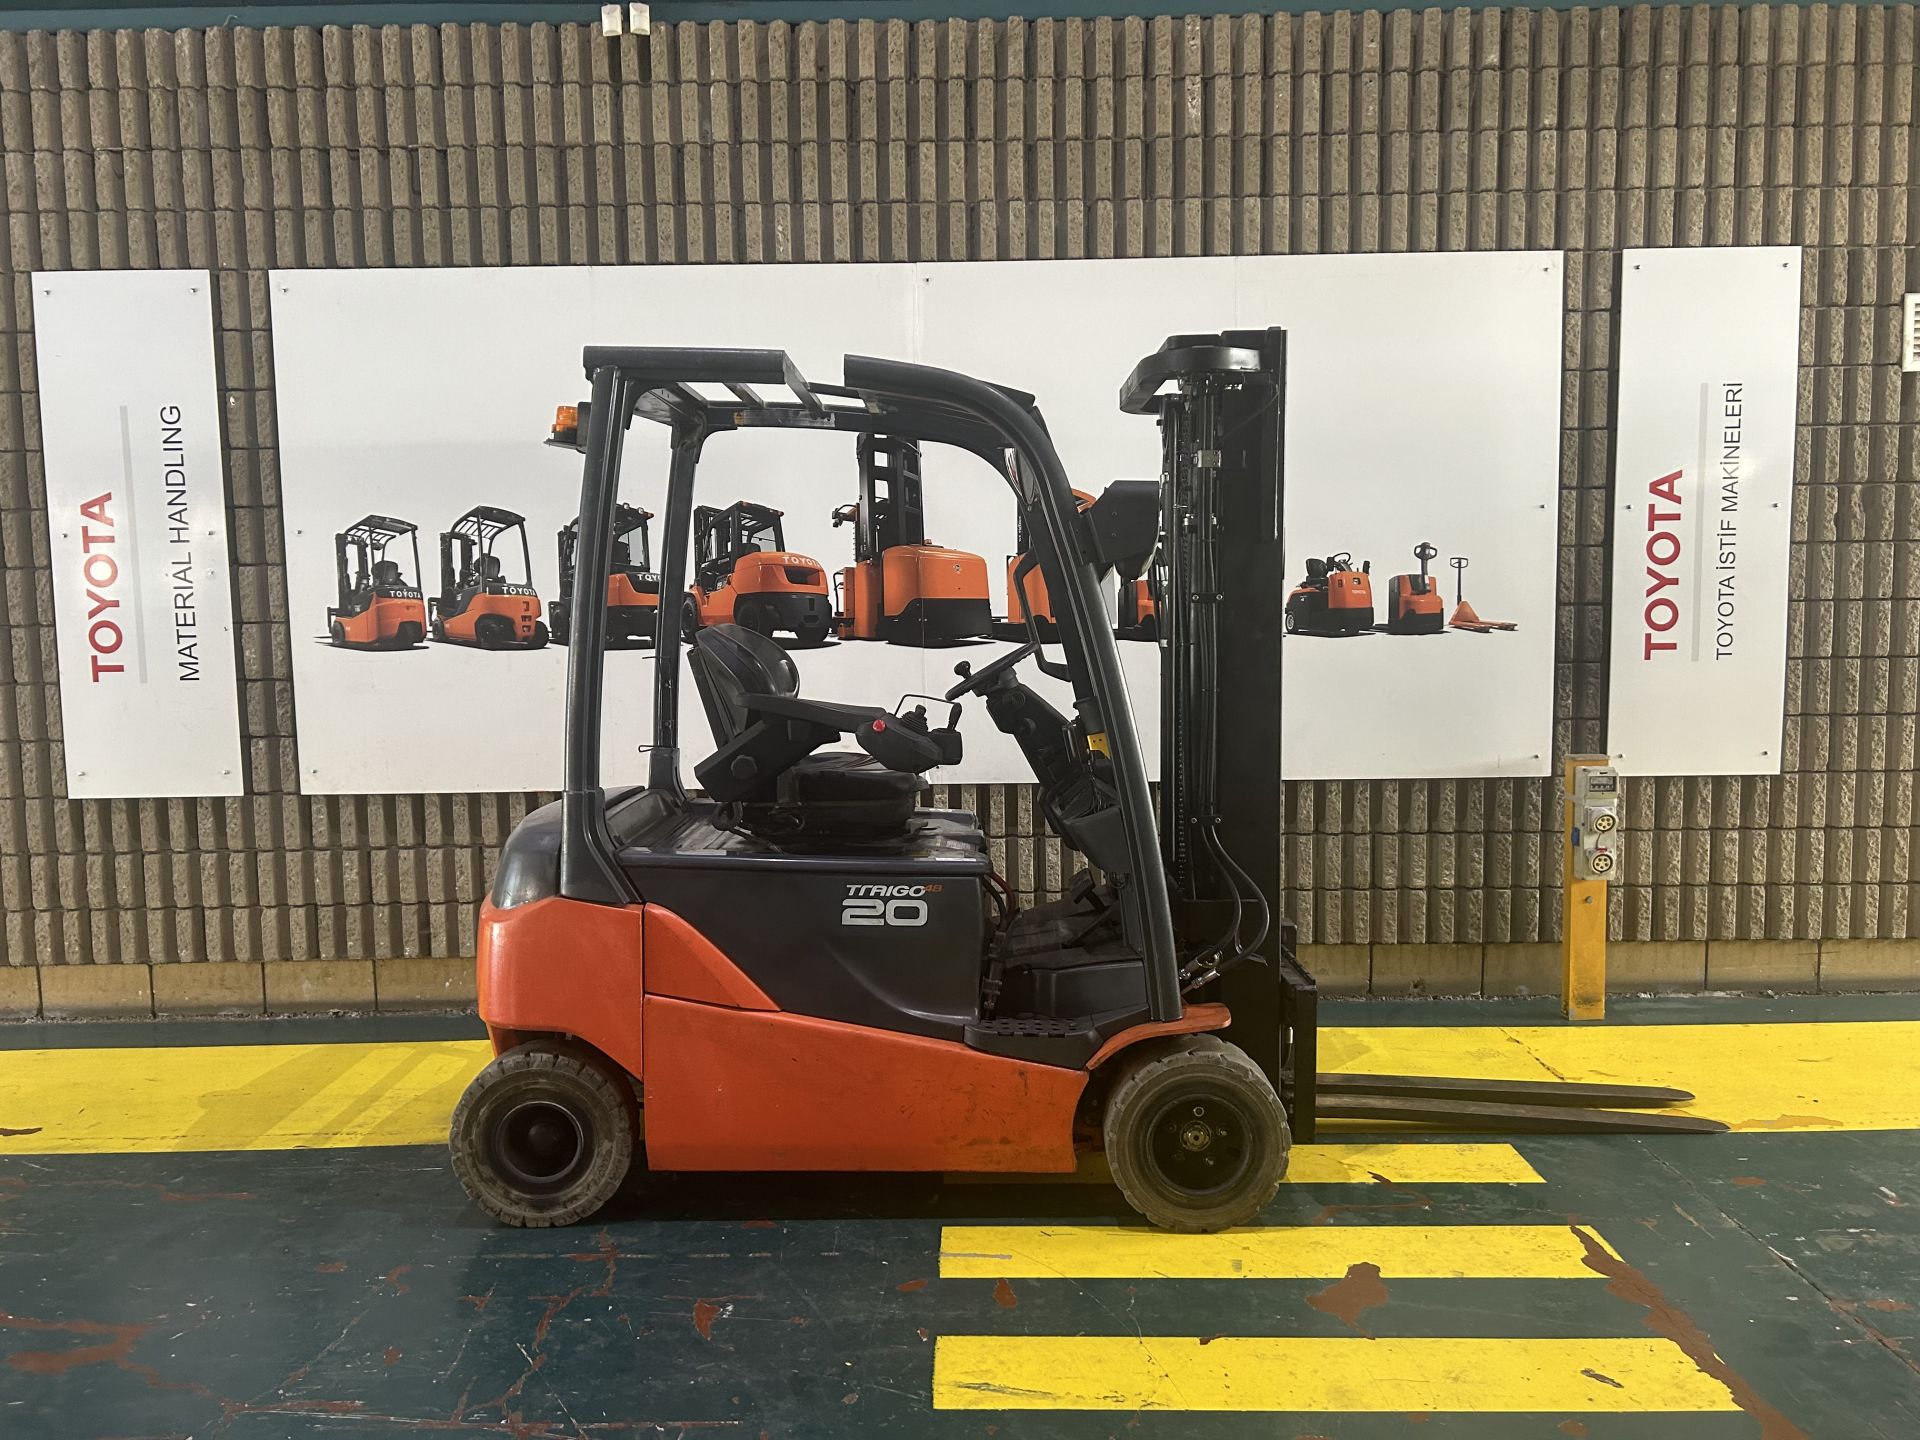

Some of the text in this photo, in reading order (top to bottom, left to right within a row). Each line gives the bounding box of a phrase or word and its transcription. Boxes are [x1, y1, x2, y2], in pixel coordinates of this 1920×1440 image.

[80, 491, 125, 683] TOYOTA
[160, 405, 200, 682] MATERIAL HANDLING
[1644, 469, 1683, 661] TOYOTA
[1716, 383, 1743, 661] TOYOTA İSTİF MAKİNELERİ
[842, 898, 928, 927] 20
[846, 884, 925, 897] TRAIGO
